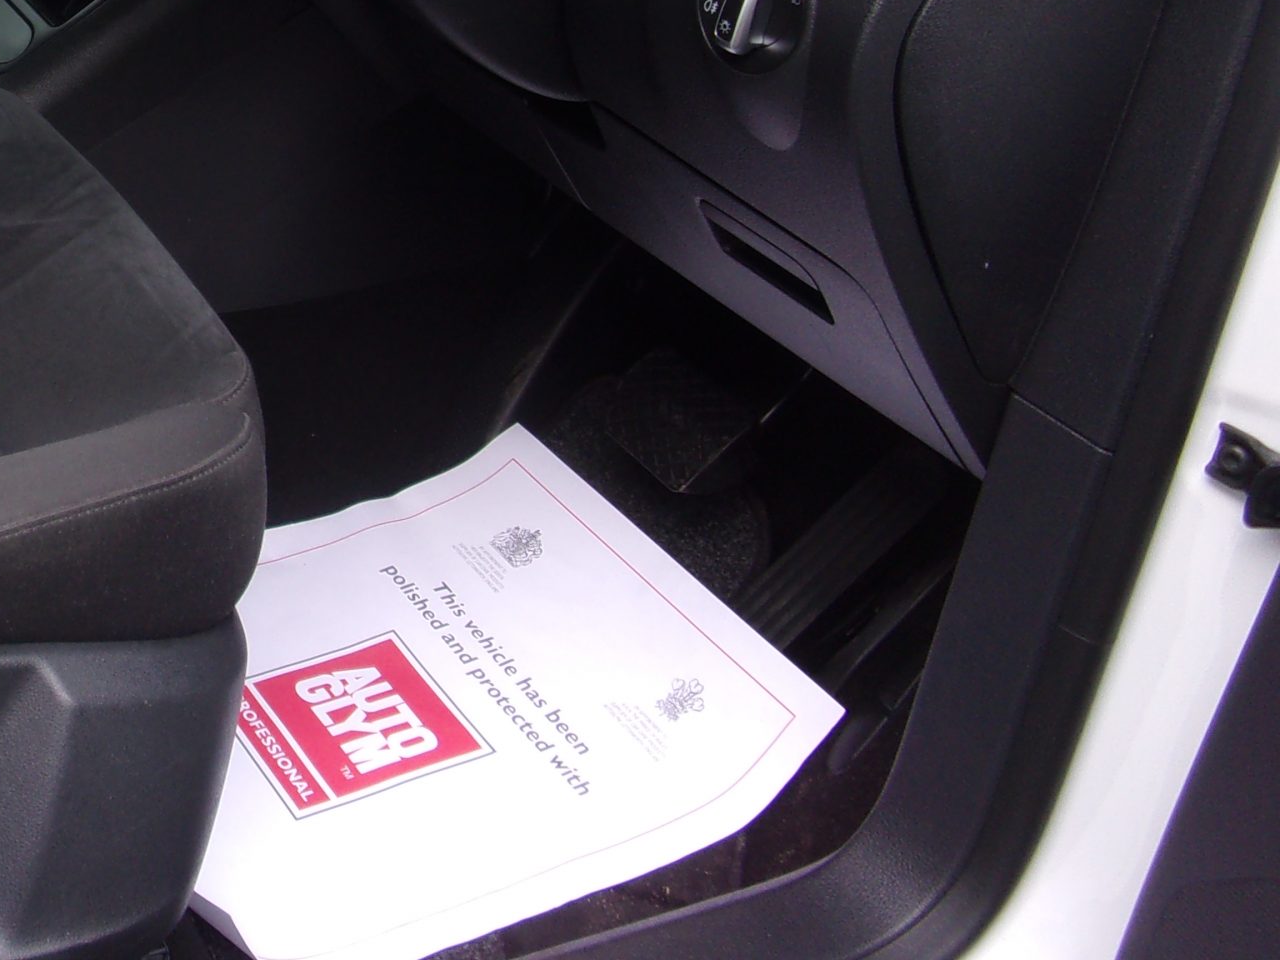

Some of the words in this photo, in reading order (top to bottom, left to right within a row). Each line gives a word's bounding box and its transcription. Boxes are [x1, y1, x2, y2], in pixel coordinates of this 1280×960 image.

[332, 666, 439, 760] AUTO
[379, 564, 449, 630] polished
[441, 633, 478, 665] and
[466, 668, 555, 752] protected
[550, 755, 590, 796] with
[433, 581, 466, 617] This
[464, 620, 518, 677] vehicle
[516, 677, 548, 709] has
[545, 709, 590, 756] been
[240, 696, 315, 803] ROFESSIONAL
[295, 673, 402, 775] GLYM
